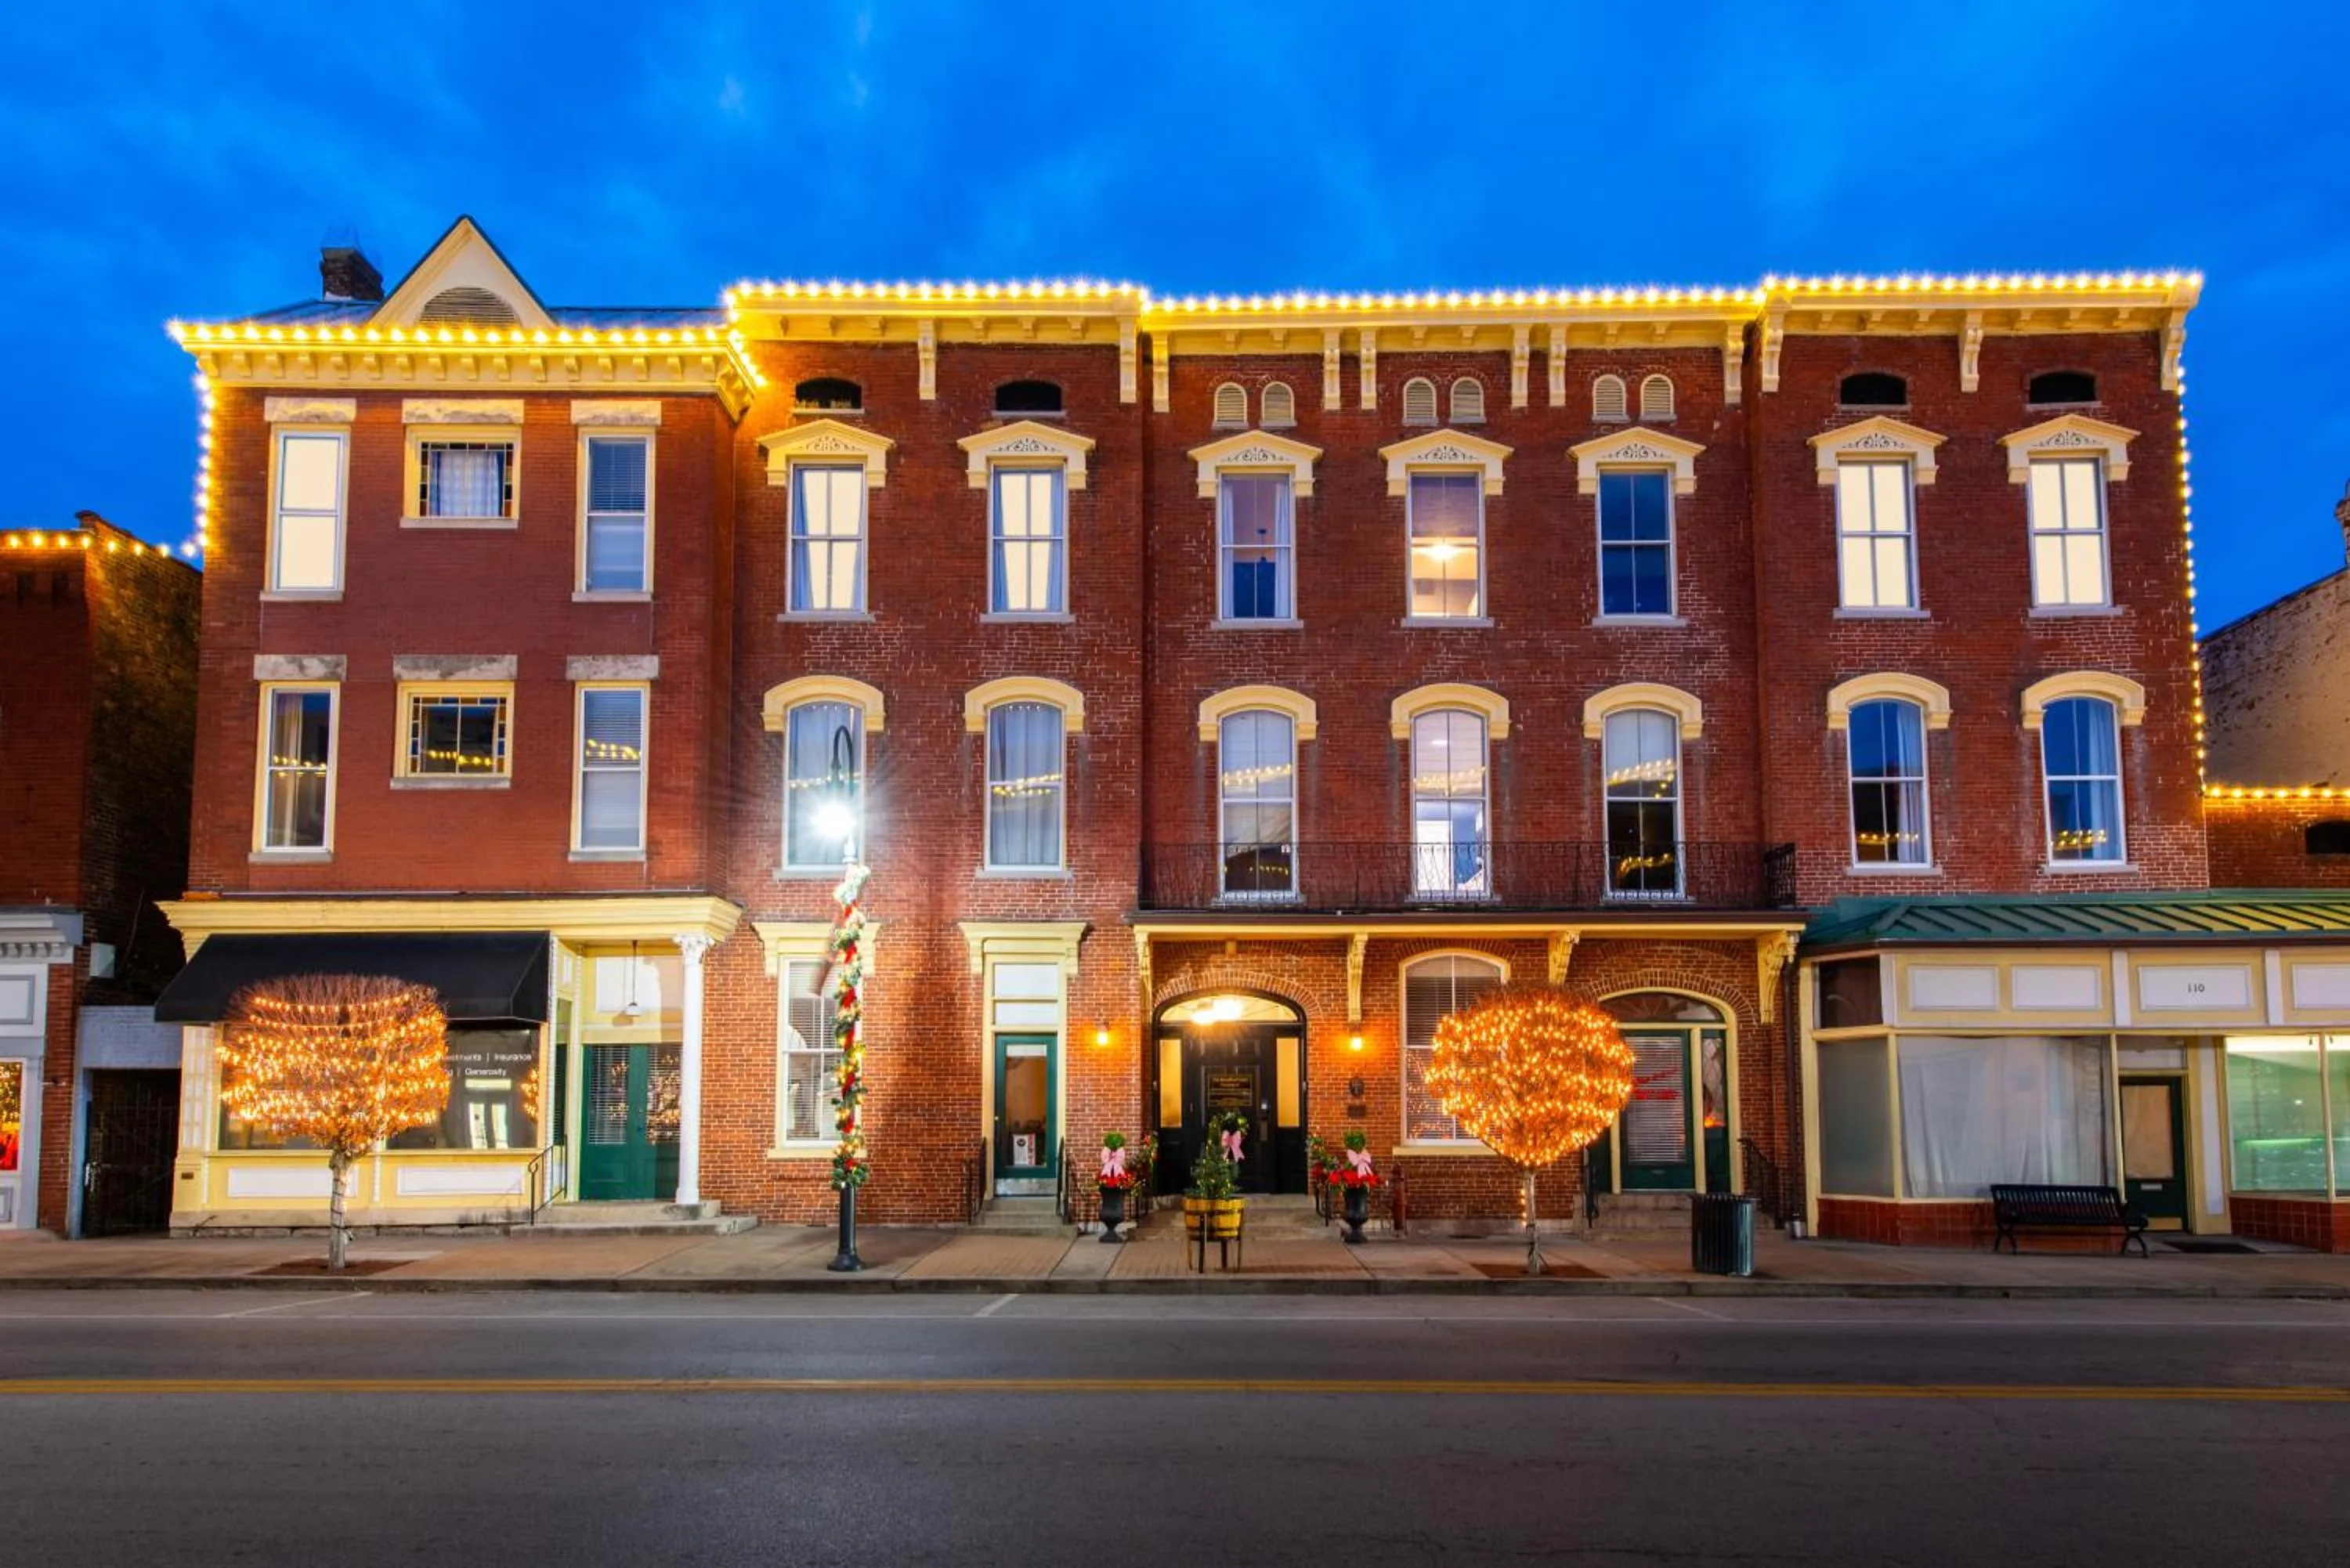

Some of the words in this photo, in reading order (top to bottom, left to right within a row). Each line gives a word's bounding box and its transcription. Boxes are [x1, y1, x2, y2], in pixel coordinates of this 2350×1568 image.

[2188, 982, 2205, 993] 110
[494, 1053, 532, 1061] Insurance
[465, 1068, 507, 1077] Generosity
